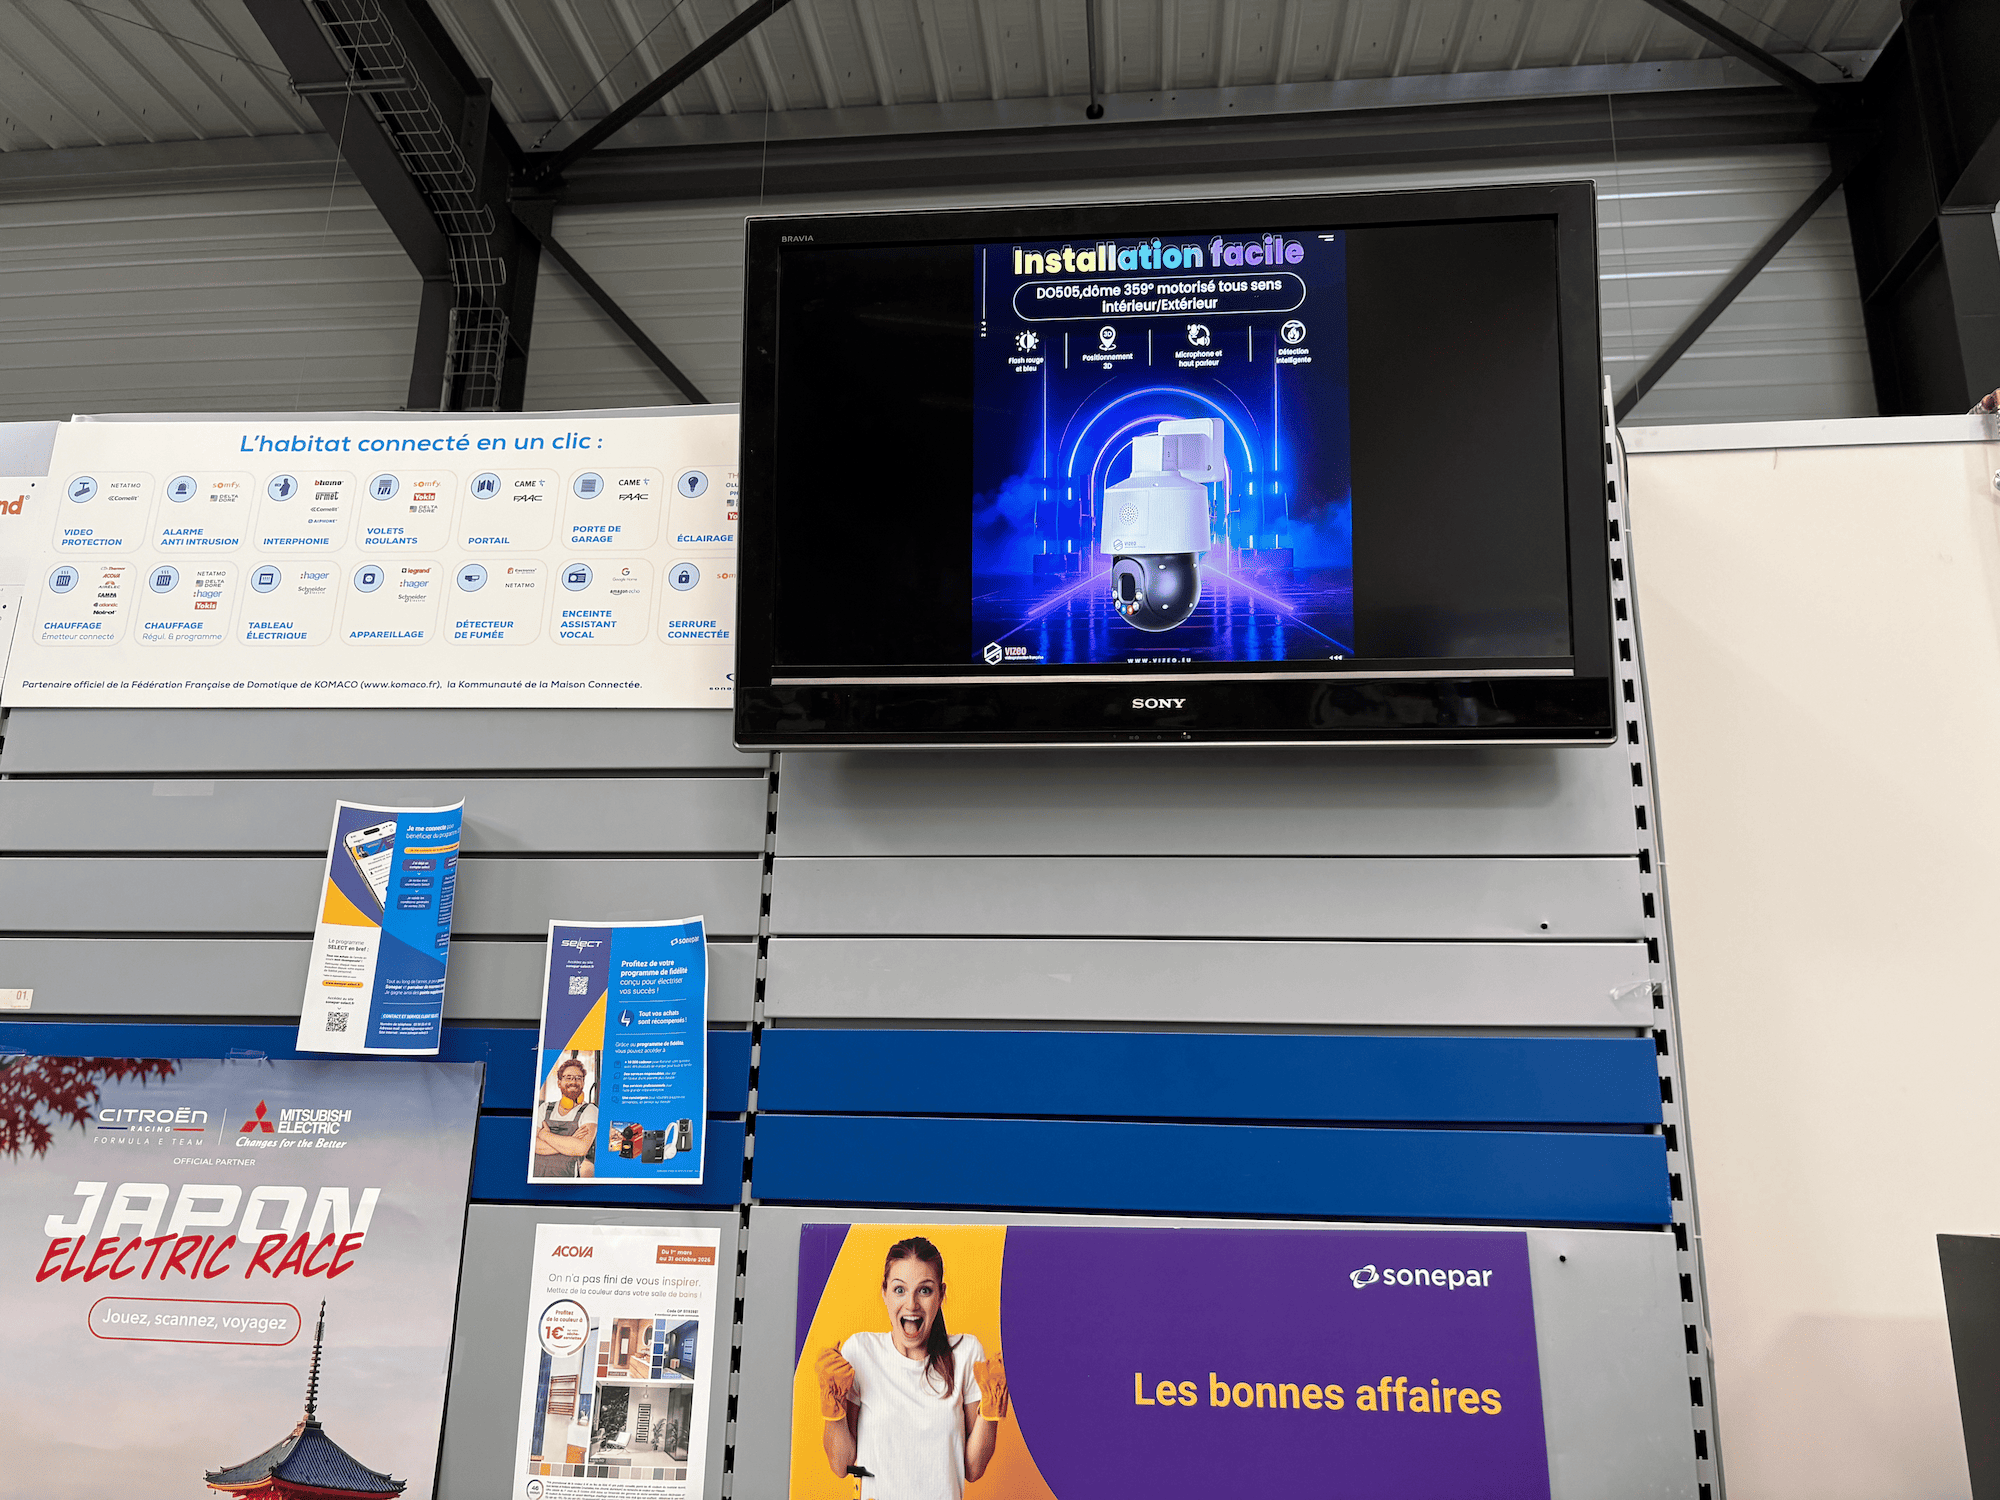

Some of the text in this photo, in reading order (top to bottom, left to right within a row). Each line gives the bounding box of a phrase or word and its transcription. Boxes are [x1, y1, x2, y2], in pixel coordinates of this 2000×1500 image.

[1013, 233, 1305, 275] Installation facile
[1036, 284, 1121, 300] DO505,dôme
[1157, 279, 1216, 295] motorisé
[1218, 279, 1248, 293] tous
[1250, 278, 1282, 291] sens
[1175, 349, 1222, 360] Microphone et
[1278, 347, 1309, 355] Détection
[1026, 357, 1044, 365] rouge
[1082, 353, 1133, 361] Positionnement
[1179, 359, 1219, 367] haut parleur
[358, 433, 470, 452] connecté
[476, 435, 506, 451] en
[514, 435, 544, 450] un
[552, 432, 591, 450] clic
[414, 493, 436, 501] Yokis
[513, 494, 543, 502] FAAC
[618, 493, 649, 501] FAAC
[63, 528, 94, 536] VIDEO
[163, 528, 204, 536] ALARME
[367, 527, 405, 535] VOLETS
[572, 525, 621, 533] PORTE DE
[61, 538, 123, 546] PROTECTION
[160, 538, 239, 546] ANTI INTRUSION
[263, 537, 330, 545] INTERPHONIE
[365, 537, 418, 545] ROULANTS
[468, 537, 510, 545] PORTAIL
[571, 535, 613, 543] GARAGE
[677, 533, 734, 542] ÉCLAIRAGE
[407, 567, 431, 575] legrand
[195, 601, 217, 610] Yokis
[562, 610, 612, 618] ENCEINTE
[43, 622, 102, 630] CHAUFFAGE
[144, 622, 203, 630] CHAUFFAGE
[455, 619, 514, 629] DÉTECTEUR
[560, 620, 617, 629] ASSISTANT
[668, 620, 717, 628] SERRURE
[41, 632, 115, 641] Émetteur connecté
[142, 632, 166, 642] Régul.
[176, 633, 222, 642] programme
[246, 630, 308, 640] ÉLECTRIQUE
[349, 630, 425, 639] APPAREILLAGE
[454, 629, 504, 639] DE FUMÉE
[559, 631, 594, 639] VOCAL
[667, 628, 730, 639] CONNECTÉE
[22, 680, 643, 691] Partenaire officiel de la Fédération Française de Domotique de KOMACO (www.komaco.fr), la Kommunauté de la Maison Connectée.
[1132, 698, 1186, 709] SONY
[620, 960, 648, 968] Profitez
[620, 967, 688, 978] programme de fidélité
[619, 977, 683, 987] conçu pour électriser
[632, 987, 656, 995] succès
[651, 1018, 685, 1026] récompensés
[280, 1108, 352, 1123] MITSUBISHI
[278, 1121, 340, 1135] ELECTRIC
[93, 1137, 149, 1145] FORMULA
[171, 1138, 203, 1146] TEAM
[235, 1137, 347, 1151] Changes for the Better
[173, 1157, 256, 1167] OFFICIAL PARTNER
[44, 1181, 382, 1246] JAPON
[551, 1245, 594, 1258] ACOVA
[35, 1232, 365, 1283] ELECTRIC RACE
[548, 1273, 563, 1283] On
[582, 1275, 601, 1286] pas
[603, 1274, 618, 1284] fini
[620, 1275, 633, 1285] de
[636, 1277, 660, 1286] vous
[662, 1276, 701, 1289] inspirer.
[1383, 1266, 1492, 1290] sonepar
[546, 1286, 569, 1294] Mettez
[587, 1287, 613, 1296] couleur
[614, 1288, 630, 1296] dans
[632, 1289, 650, 1297] votre
[650, 1289, 667, 1297] salle
[667, 1290, 678, 1298] de
[678, 1290, 698, 1299] bains
[102, 1308, 287, 1333] Jouez, scannez, voyagez
[1134, 1372, 1502, 1416] Les bonnes affaires
